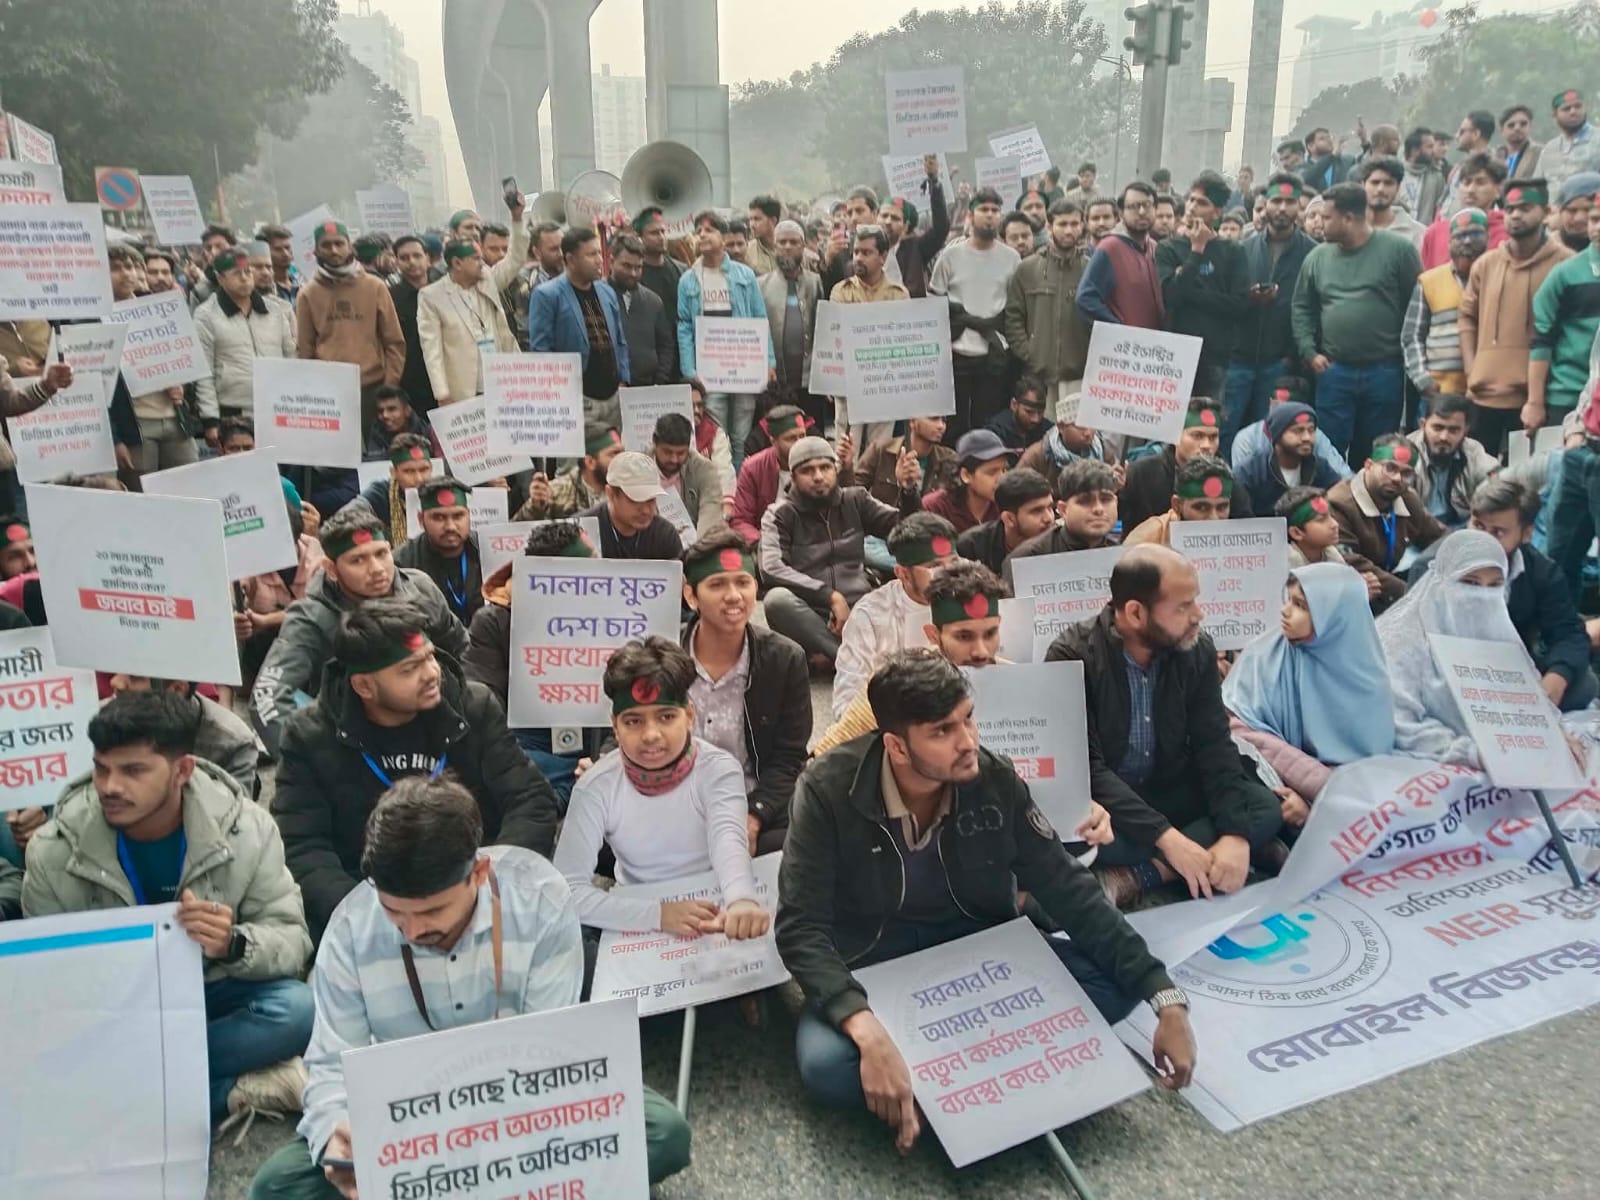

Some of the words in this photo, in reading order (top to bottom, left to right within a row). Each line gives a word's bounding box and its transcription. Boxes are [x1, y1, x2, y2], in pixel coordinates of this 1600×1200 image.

[146, 594, 176, 617] চাই
[528, 574, 612, 596] দালাল
[619, 577, 667, 606] মুক্ত
[547, 616, 597, 637] দেশ
[604, 612, 648, 637] চাই
[0, 677, 73, 711] তার
[538, 683, 600, 704] ক্ষমা
[19, 722, 74, 745] জন্য
[1330, 800, 1406, 863] NEIR
[611, 938, 671, 955] আমাদের
[1423, 903, 1538, 948] NEIR
[653, 979, 686, 999] স্কুলে
[911, 971, 984, 1010] সরকার
[982, 959, 1012, 986] কি
[1208, 983, 1253, 1000] আদর্শ
[1258, 990, 1291, 1001] ঠিক
[918, 1009, 987, 1043] আমার
[985, 986, 1045, 1020] বাবার
[1248, 993, 1448, 1073] মোবাইল
[911, 1051, 968, 1088] নতুন
[968, 1005, 1090, 1064] কর্মসংস্থানের
[388, 1092, 440, 1123] চলে
[448, 1078, 505, 1110] গেছে
[508, 1057, 609, 1098] স্বৈরাচার
[936, 1076, 1005, 1115] ব্যবস্থা
[1003, 1059, 1049, 1091] করে
[1045, 1036, 1104, 1075] দিবে?
[377, 1133, 438, 1167] এখন
[446, 1120, 499, 1150] কেন
[503, 1092, 625, 1136] অত্যাচার?
[391, 1163, 479, 1200] ফিরিয়ে
[486, 1157, 512, 1183] দে
[516, 1134, 620, 1175] অধিকার
